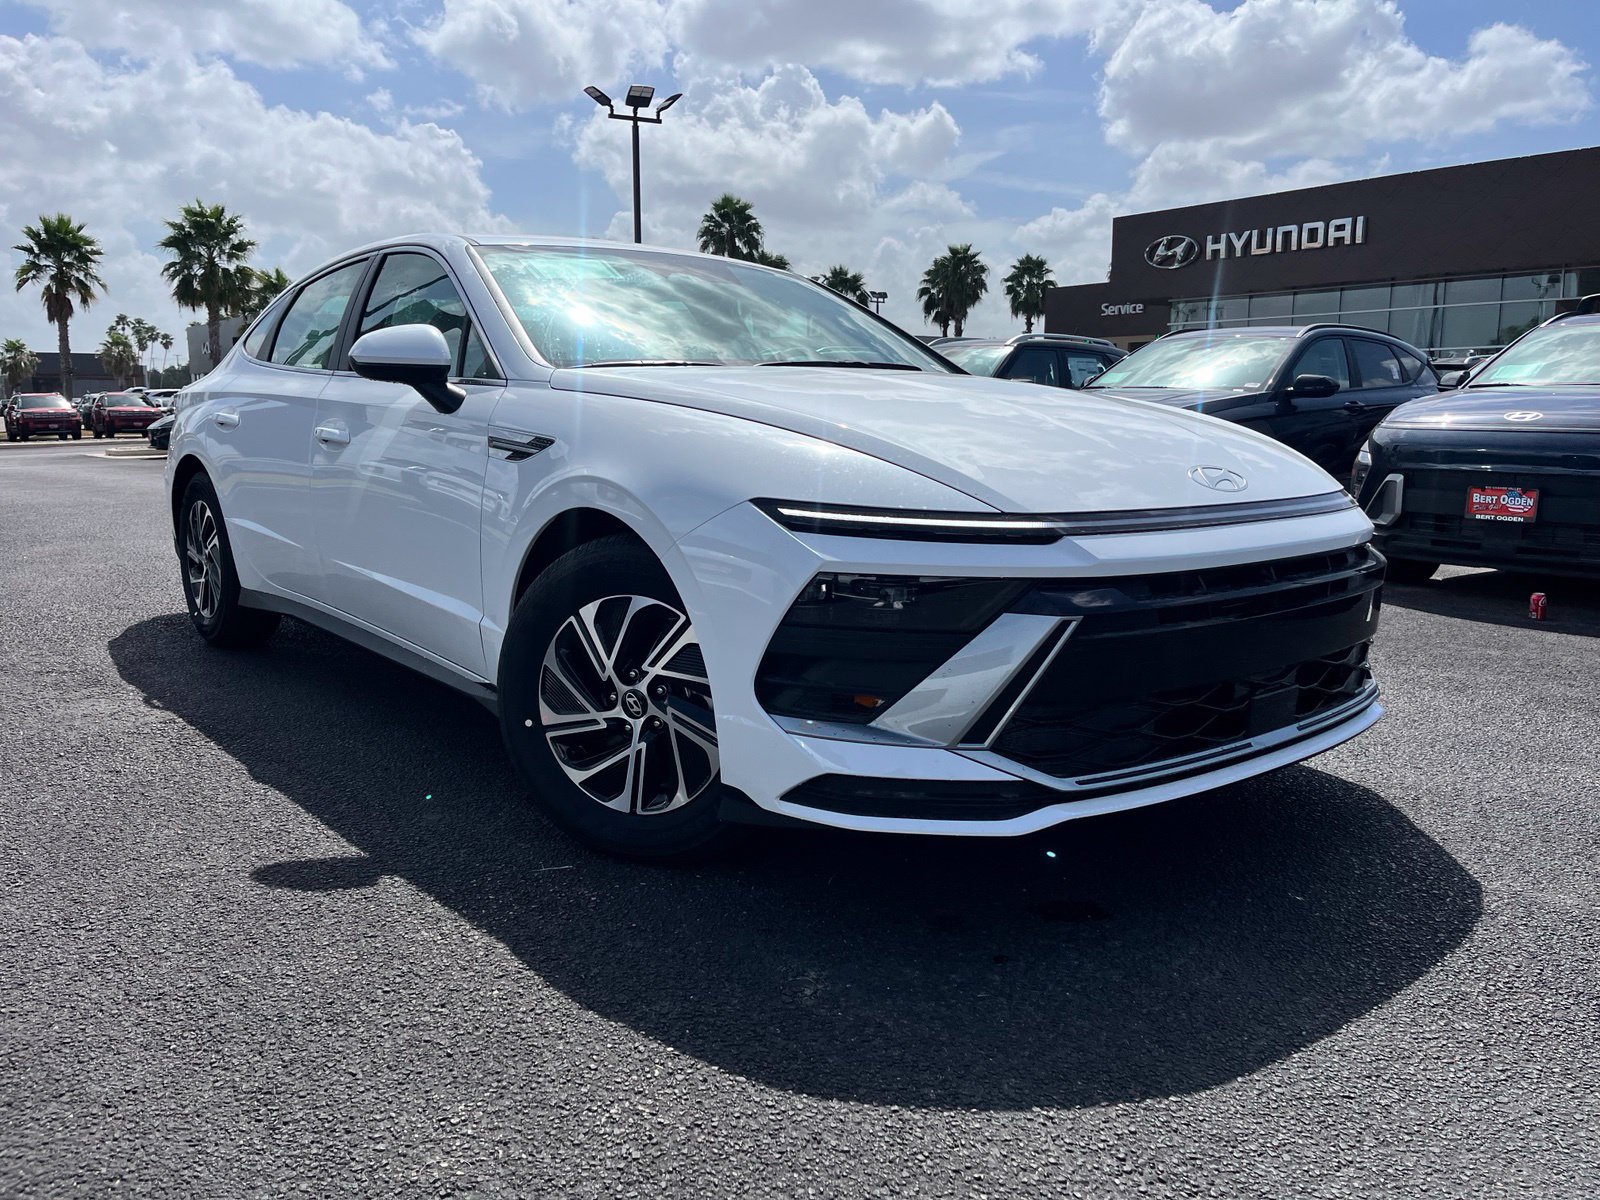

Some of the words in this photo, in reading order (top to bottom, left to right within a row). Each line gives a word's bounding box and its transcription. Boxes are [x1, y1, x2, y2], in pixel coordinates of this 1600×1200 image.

[1206, 216, 1366, 260] HYUNDAI
[1101, 302, 1144, 316] Service
[1473, 493, 1498, 504] BERT
[1500, 494, 1534, 506] OGDEN
